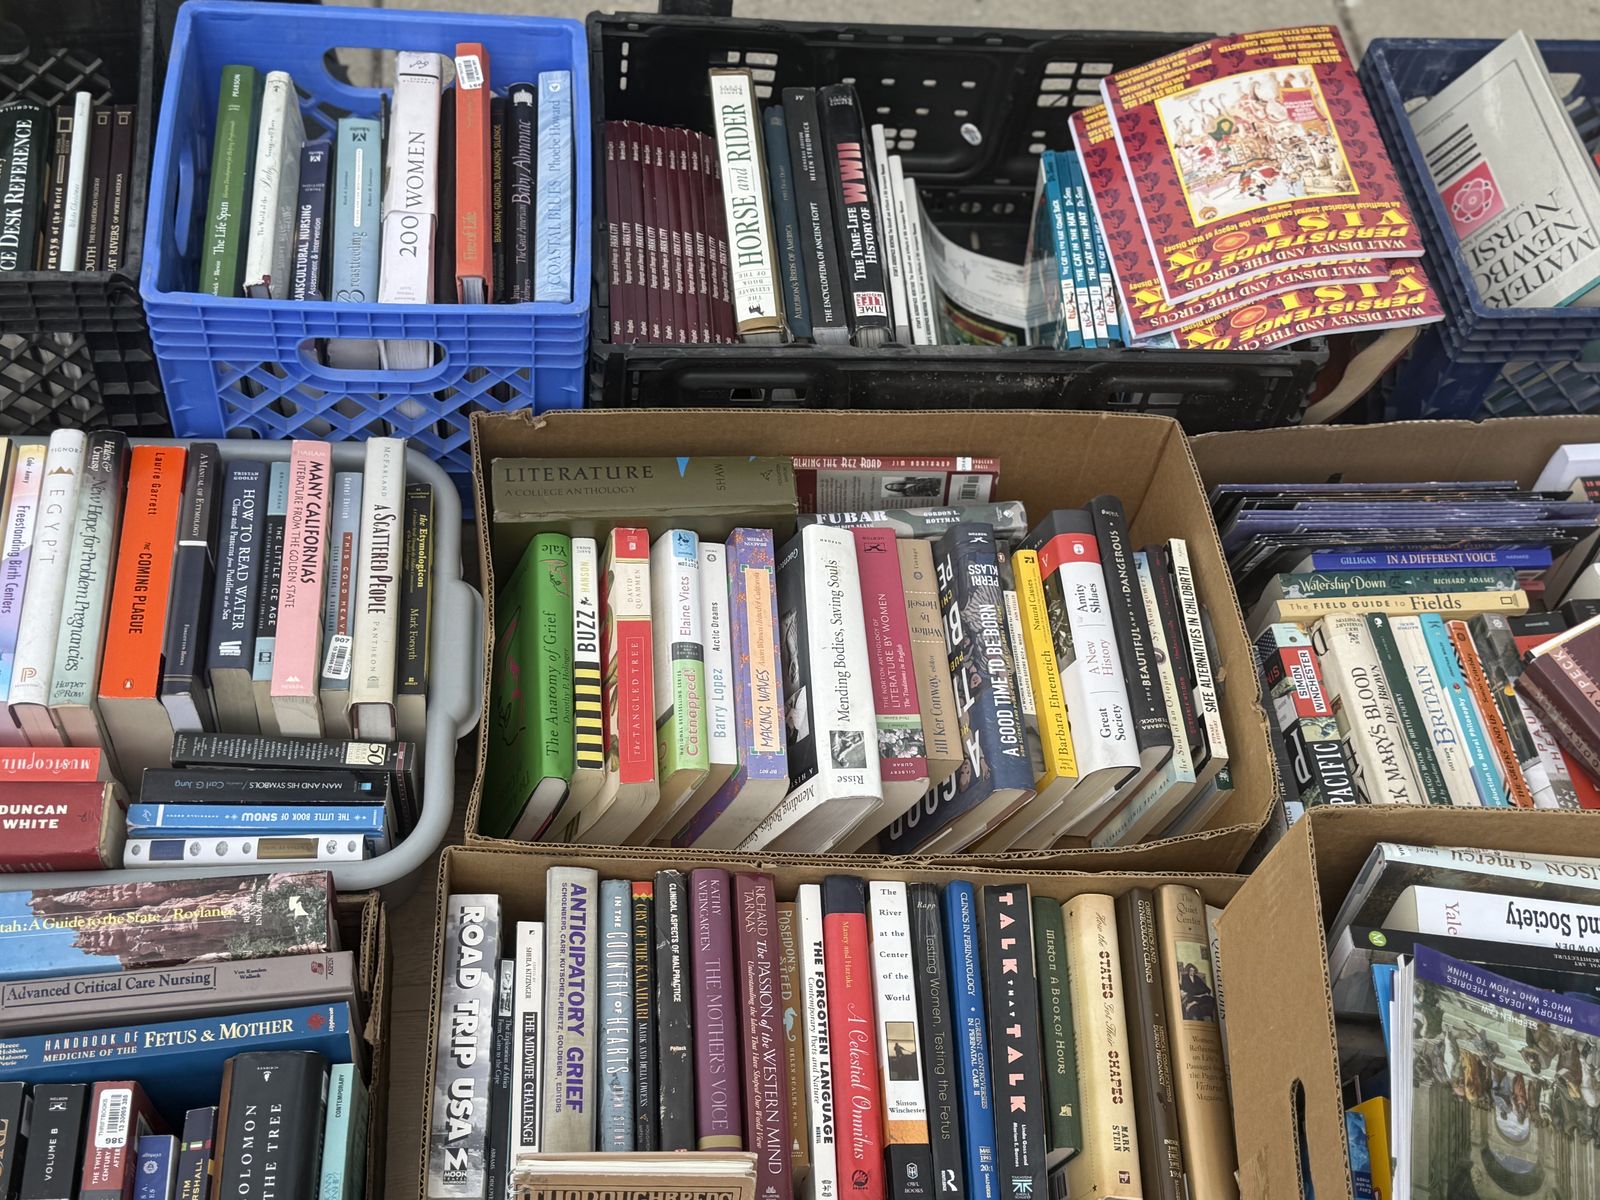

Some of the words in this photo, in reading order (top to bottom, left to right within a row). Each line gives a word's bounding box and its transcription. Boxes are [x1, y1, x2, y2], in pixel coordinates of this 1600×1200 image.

[232, 74, 240, 97] PEARSON
[548, 100, 561, 136] Howard
[722, 104, 751, 163] RIDER
[4, 120, 32, 204] REFERENCE
[406, 131, 425, 208] WOMEN
[548, 138, 561, 172] Phoebe
[737, 168, 751, 191] and
[837, 143, 868, 205] WWII
[216, 201, 229, 220] Span
[548, 179, 562, 218] BLUES
[1, 208, 22, 248] DESK
[214, 220, 227, 239] Life
[733, 195, 763, 267] HORSE
[847, 207, 863, 257] TIME-LIFE
[861, 207, 871, 226] OF
[213, 239, 225, 255] The
[400, 215, 419, 257] 200
[548, 220, 562, 285] COASTAL
[862, 226, 877, 263] HISTORY
[1312, 241, 1364, 255] DISNEY
[1372, 239, 1407, 248] WALT
[854, 259, 866, 281] THE
[1244, 255, 1274, 268] THE
[1277, 247, 1309, 261] AND
[1185, 265, 1240, 291] CIRCUS
[152, 452, 165, 479] Laurie
[294, 460, 306, 503] LITERATURE
[306, 460, 324, 501] MANY
[505, 465, 654, 483] LITERATURE
[93, 476, 103, 501] New
[148, 481, 161, 515] Garrett
[242, 489, 255, 520] HOW
[89, 501, 103, 531] Hope
[240, 522, 252, 542] TO
[292, 503, 302, 529] FROM
[816, 511, 888, 525] FUBAR
[89, 531, 101, 550] for
[291, 531, 300, 546] THE
[300, 502, 321, 584] CALIFORNIAS
[371, 514, 396, 571] SCATTERED
[79, 549, 97, 595] Problem
[237, 548, 250, 581] READ
[273, 545, 282, 579] LITTLE
[288, 547, 299, 583] GOLDEN
[825, 559, 838, 587] Souls
[1339, 556, 1376, 565] GILLIGAN
[1387, 555, 1398, 564] IN
[1400, 555, 1408, 564] A
[1409, 553, 1462, 564] DIFFERENT
[1465, 552, 1498, 562] VOICE
[270, 584, 278, 601] ICE
[285, 585, 296, 608] STATE
[368, 574, 393, 614] PEOPLE
[680, 576, 690, 604] Viets
[1299, 575, 1351, 594] Watership
[1351, 576, 1386, 592] Down
[1433, 577, 1466, 585] RICHARD
[1469, 576, 1495, 584] ADAMS
[232, 585, 247, 630] WATER
[830, 590, 844, 625] Saving
[878, 593, 890, 632] WOMEN
[1077, 583, 1088, 612] Amity
[1090, 583, 1101, 613] Shlaes
[268, 606, 277, 626] AGE
[577, 610, 596, 652] BUZZ
[680, 606, 692, 636] Elaine
[979, 604, 998, 636] BORN
[64, 597, 90, 671] Pregnancies
[833, 628, 844, 668] Bodies,
[883, 633, 892, 647] BY
[986, 638, 1002, 656] BE
[990, 657, 1004, 675] TO
[1100, 639, 1114, 676] History
[713, 667, 727, 702] Lopez
[760, 669, 770, 703] WAVES
[884, 649, 901, 708] LITERATURE
[994, 676, 1008, 704] TIME
[1042, 650, 1061, 708] Ehrenreich
[1293, 667, 1307, 696] SIMON
[1300, 651, 1325, 711] WINCHESTER
[834, 671, 851, 721] Mending
[1414, 665, 1457, 746] BRITAIN
[713, 706, 727, 738] Barry
[760, 706, 774, 748] MAKING
[1000, 706, 1018, 742] GOOD
[1053, 710, 1070, 756] Barbara
[1100, 707, 1111, 738] Great
[1111, 703, 1126, 741] Society
[368, 743, 384, 765] 50
[1004, 746, 1019, 757] A
[837, 774, 864, 784] Risse
[0, 805, 67, 814] DUNCAN
[3, 819, 59, 829] WHITE
[241, 812, 278, 821] SNOW
[314, 813, 335, 821] LITTLE
[669, 883, 677, 912] CLINICAL
[711, 879, 721, 916] KATHY
[744, 891, 756, 933] TARNAS
[755, 885, 768, 937] RICHARD
[670, 913, 678, 943] ASPECTS
[1445, 901, 1462, 935] Yale
[1506, 901, 1571, 937] Society
[456, 906, 486, 990] ROAD
[567, 883, 587, 1037] ANTICIPATORY
[607, 932, 628, 997] COUNTRY
[671, 945, 678, 954] OF
[813, 940, 822, 965] THE
[7, 980, 71, 1001] Advanced
[74, 977, 122, 994] Critical
[125, 976, 156, 991] Care
[158, 972, 211, 990] Nursing
[672, 955, 681, 1002] MALPRACTICE
[705, 958, 722, 990] THE
[1099, 950, 1113, 1000] STATES
[1446, 975, 1488, 997] THEORIES
[614, 1001, 622, 1013] OF
[815, 971, 829, 1055] FORGOTTEN
[1499, 995, 1525, 1009] IDEAS
[1535, 1007, 1573, 1024] HISTORY
[144, 1029, 197, 1049] FETUS
[200, 1029, 214, 1042] &
[219, 1018, 293, 1042] MOTHER
[450, 999, 480, 1069] TRIP
[524, 1013, 536, 1035] THE
[706, 995, 728, 1075] MOTHER'S
[43, 1050, 96, 1062] MEDICINE
[99, 1048, 113, 1057] OF
[116, 1046, 137, 1056] THE
[44, 1033, 116, 1051] HANDBOOK
[125, 1031, 139, 1044] OF
[607, 1017, 629, 1074] HEARTS
[523, 1037, 537, 1088] MIDWIFE
[1108, 1051, 1124, 1105] SHAPES
[335, 1073, 344, 1118] CONTEMPORARY
[565, 1047, 584, 1113] GRIEF
[448, 1078, 474, 1141] USA
[522, 1089, 535, 1143] CHALLENGE
[711, 1076, 729, 1130] VOICE
[820, 1061, 833, 1144] LANGUAGE
